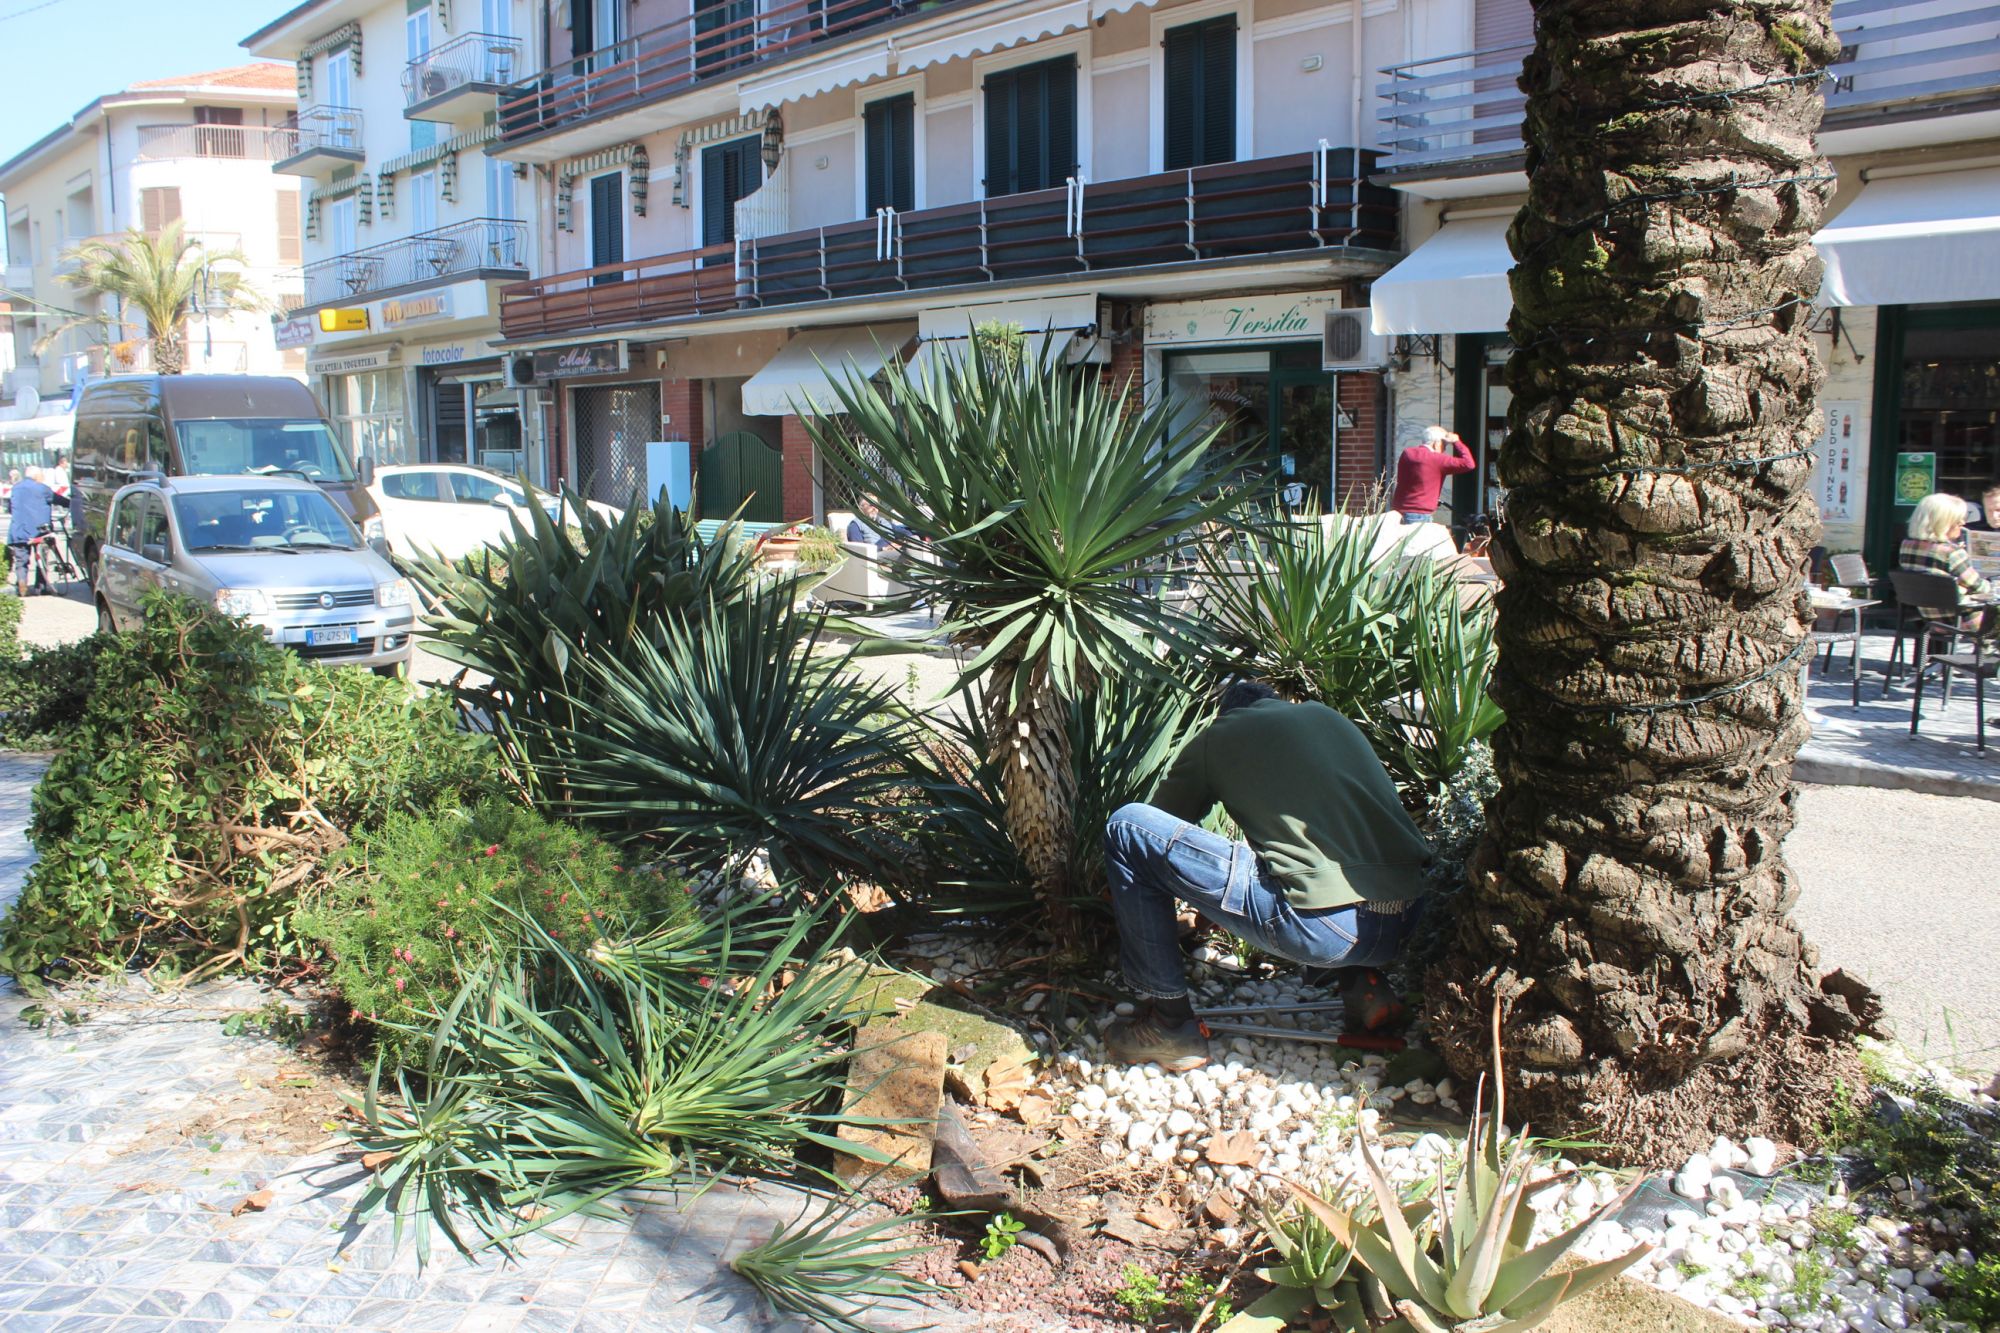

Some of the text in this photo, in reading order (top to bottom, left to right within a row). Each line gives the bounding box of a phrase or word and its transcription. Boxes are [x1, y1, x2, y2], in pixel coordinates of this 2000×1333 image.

[1224, 304, 1310, 336] Versilia
[422, 343, 464, 364] fotocolor
[314, 362, 342, 373] GELATERIA
[1826, 409, 1838, 502] COLD DRINKS
